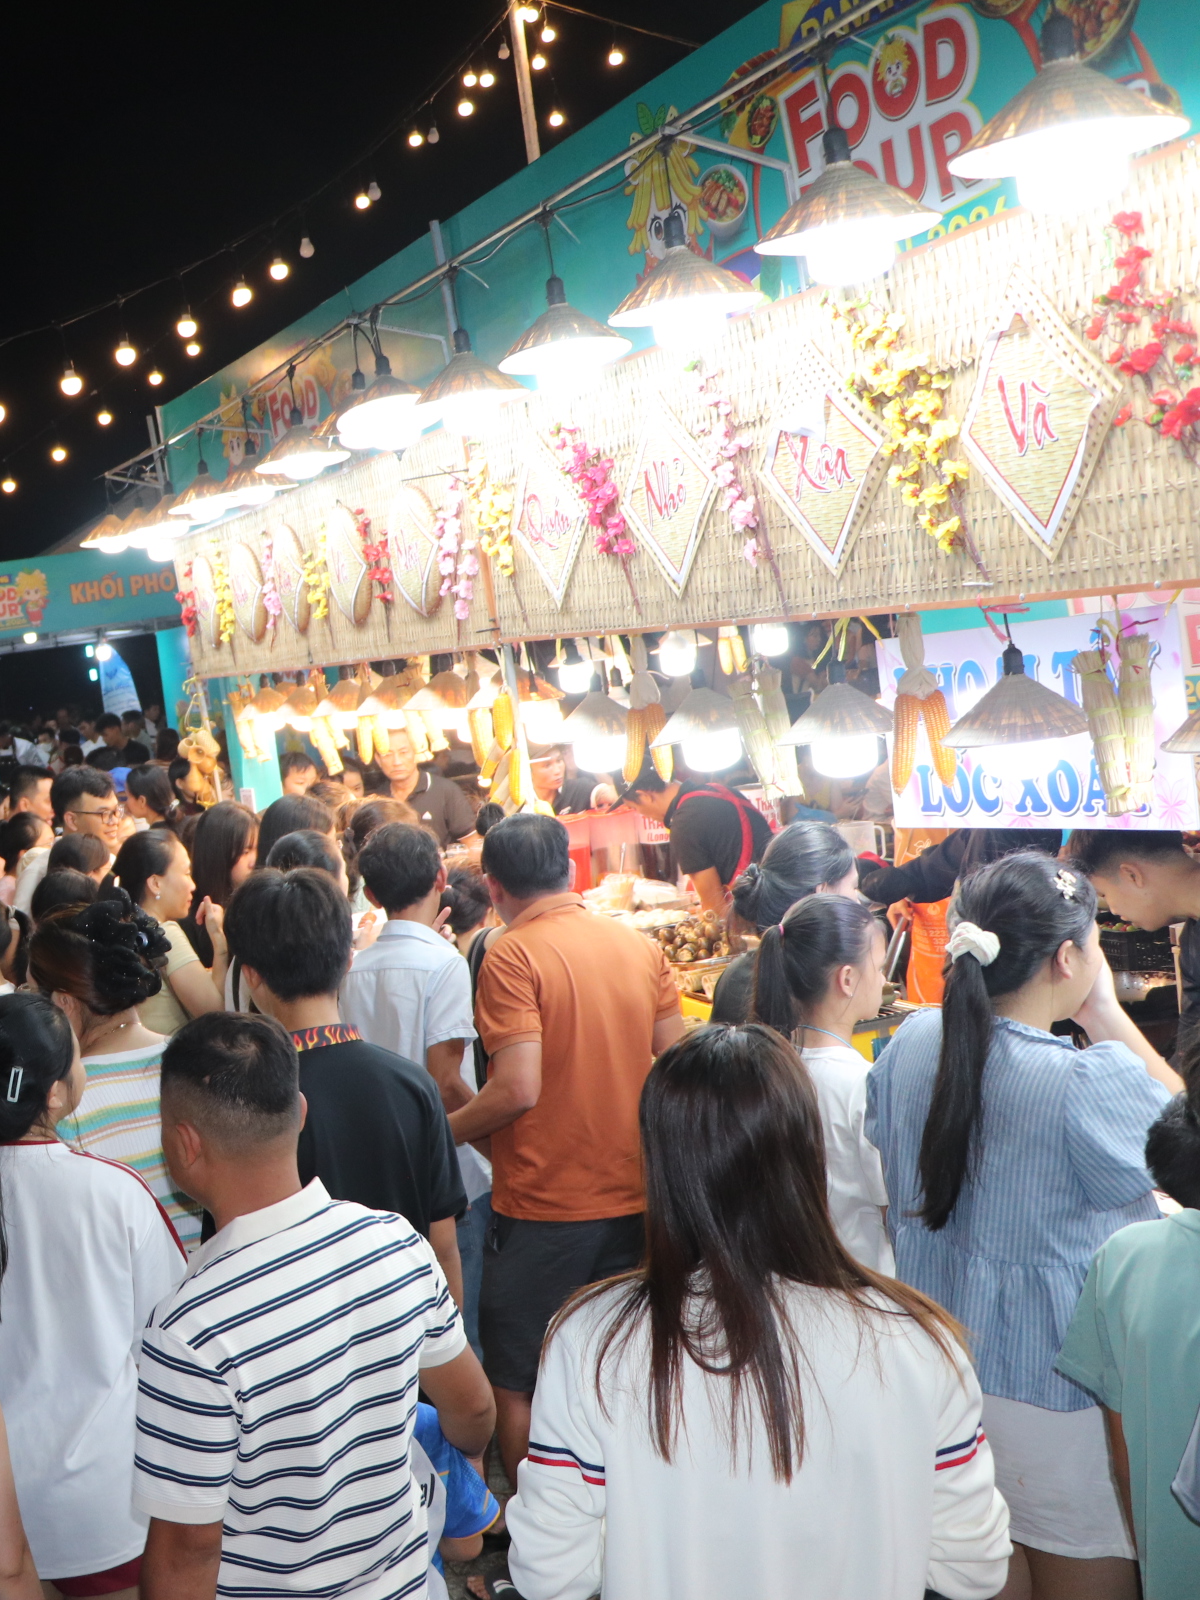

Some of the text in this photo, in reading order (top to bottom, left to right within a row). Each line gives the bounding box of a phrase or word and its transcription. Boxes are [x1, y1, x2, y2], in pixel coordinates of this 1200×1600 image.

[785, 17, 968, 178] FOOD
[997, 375, 1058, 456] Và
[69, 571, 125, 604] KHỐI
